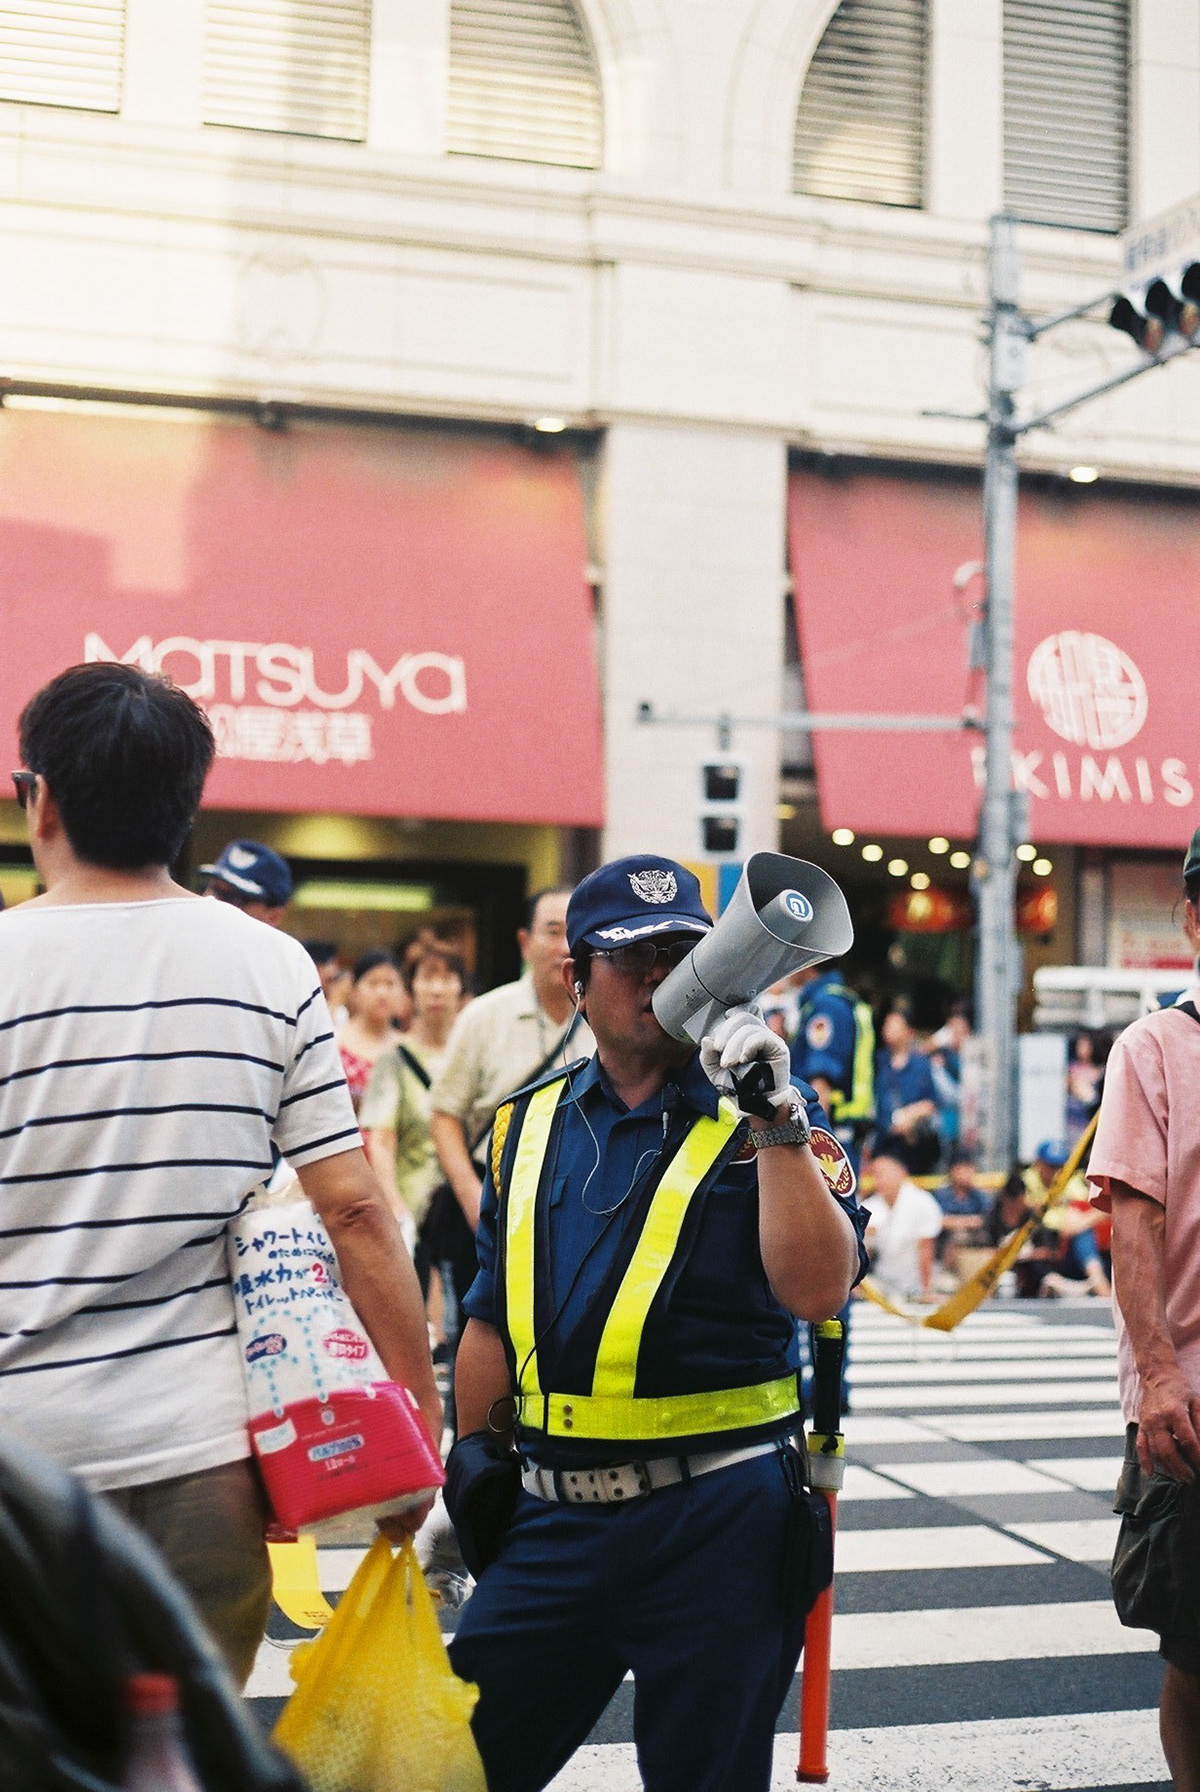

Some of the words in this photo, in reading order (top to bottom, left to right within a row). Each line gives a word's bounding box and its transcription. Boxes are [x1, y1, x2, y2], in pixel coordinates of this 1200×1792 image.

[969, 746, 1200, 808] KIMIS
[234, 1227, 326, 1256] シャワートイレ
